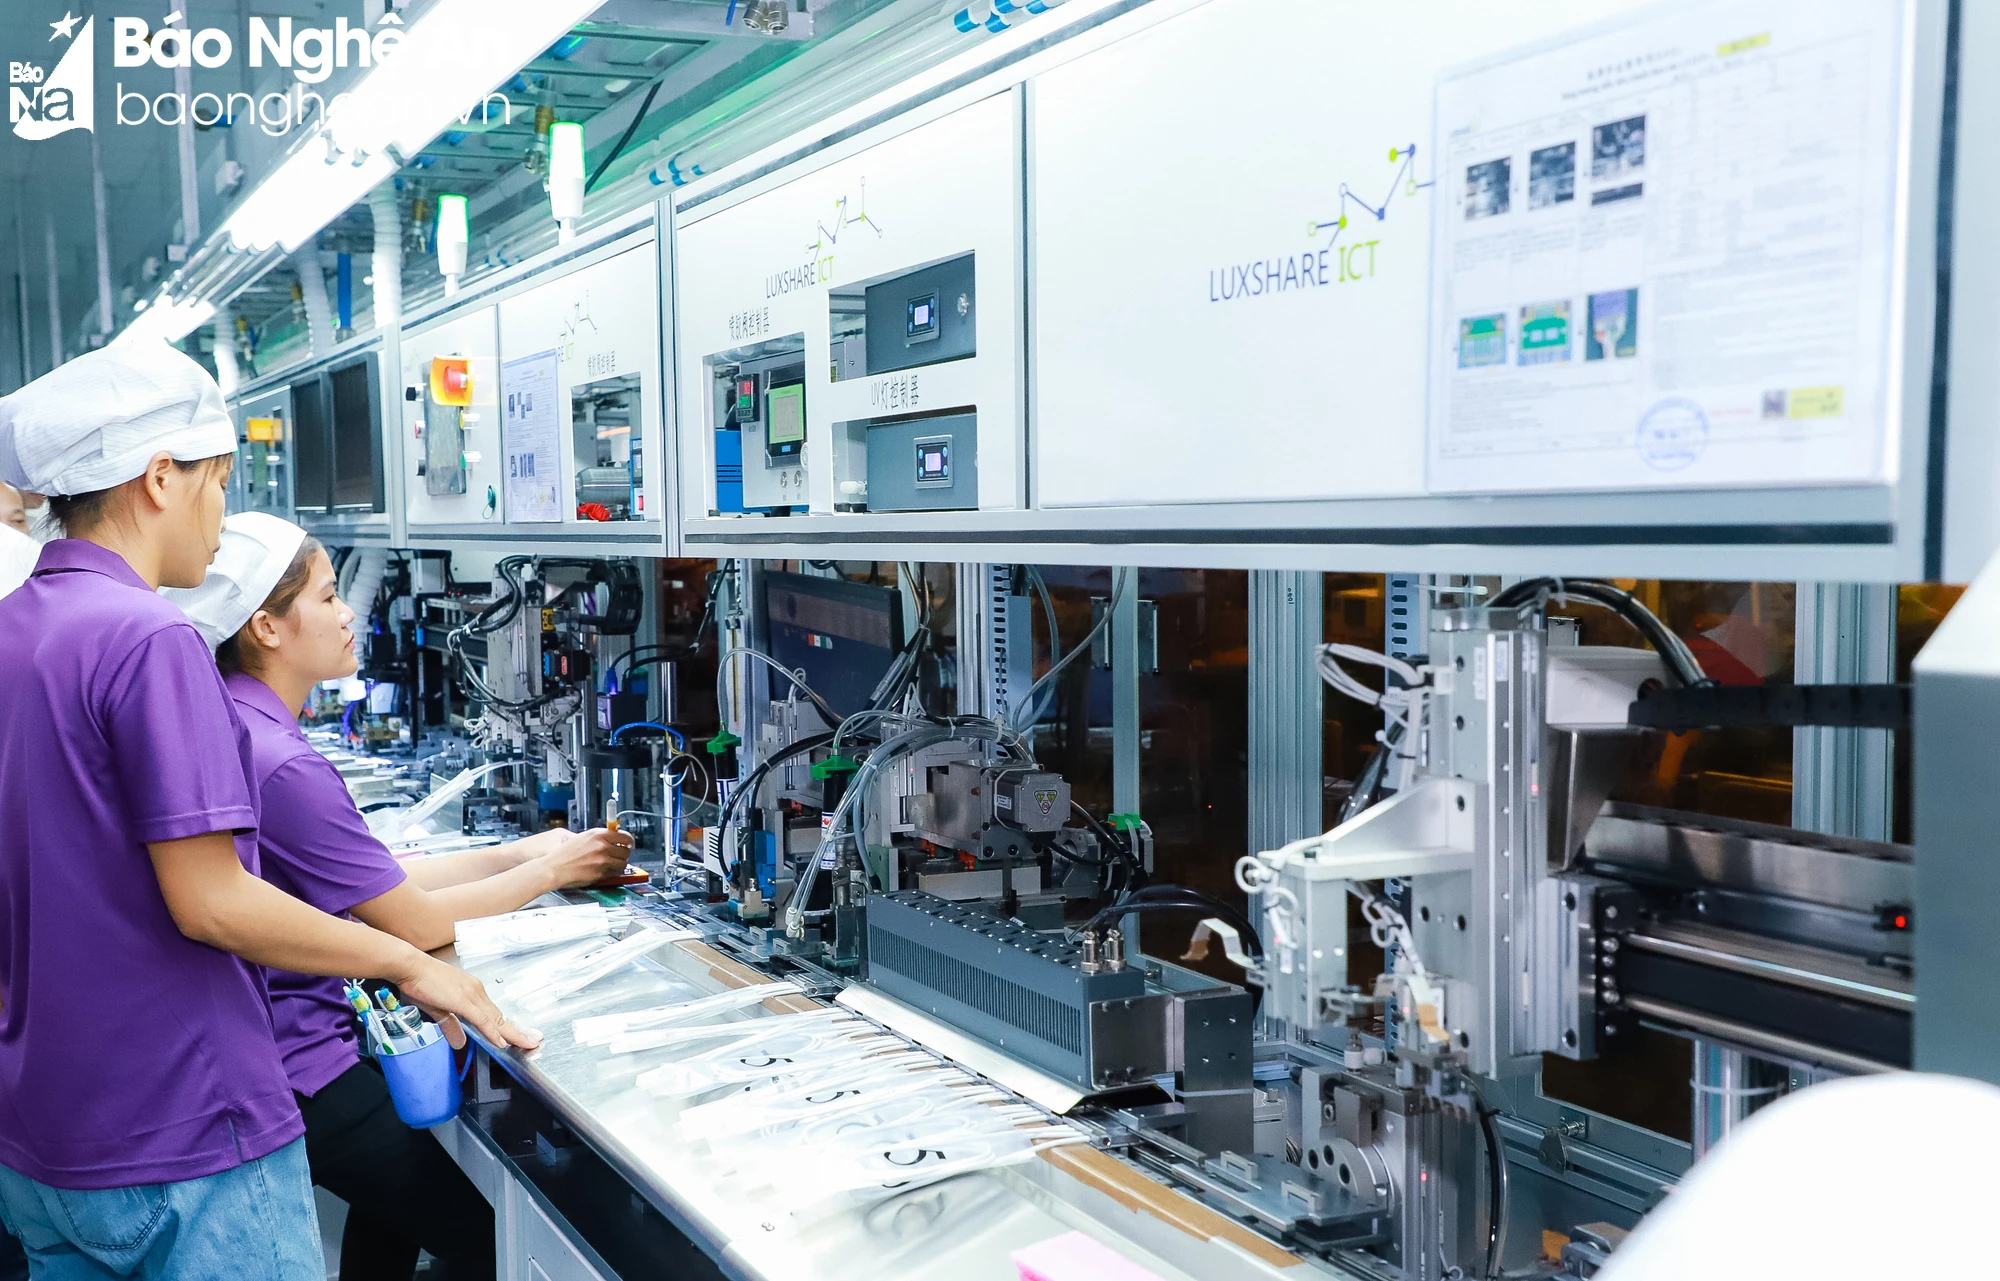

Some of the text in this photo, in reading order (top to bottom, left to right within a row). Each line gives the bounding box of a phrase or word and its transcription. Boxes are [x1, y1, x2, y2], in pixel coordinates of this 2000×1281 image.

[765, 255, 835, 299] LUXSHARE ICT
[1210, 240, 1380, 302] LUXSHARE ICT
